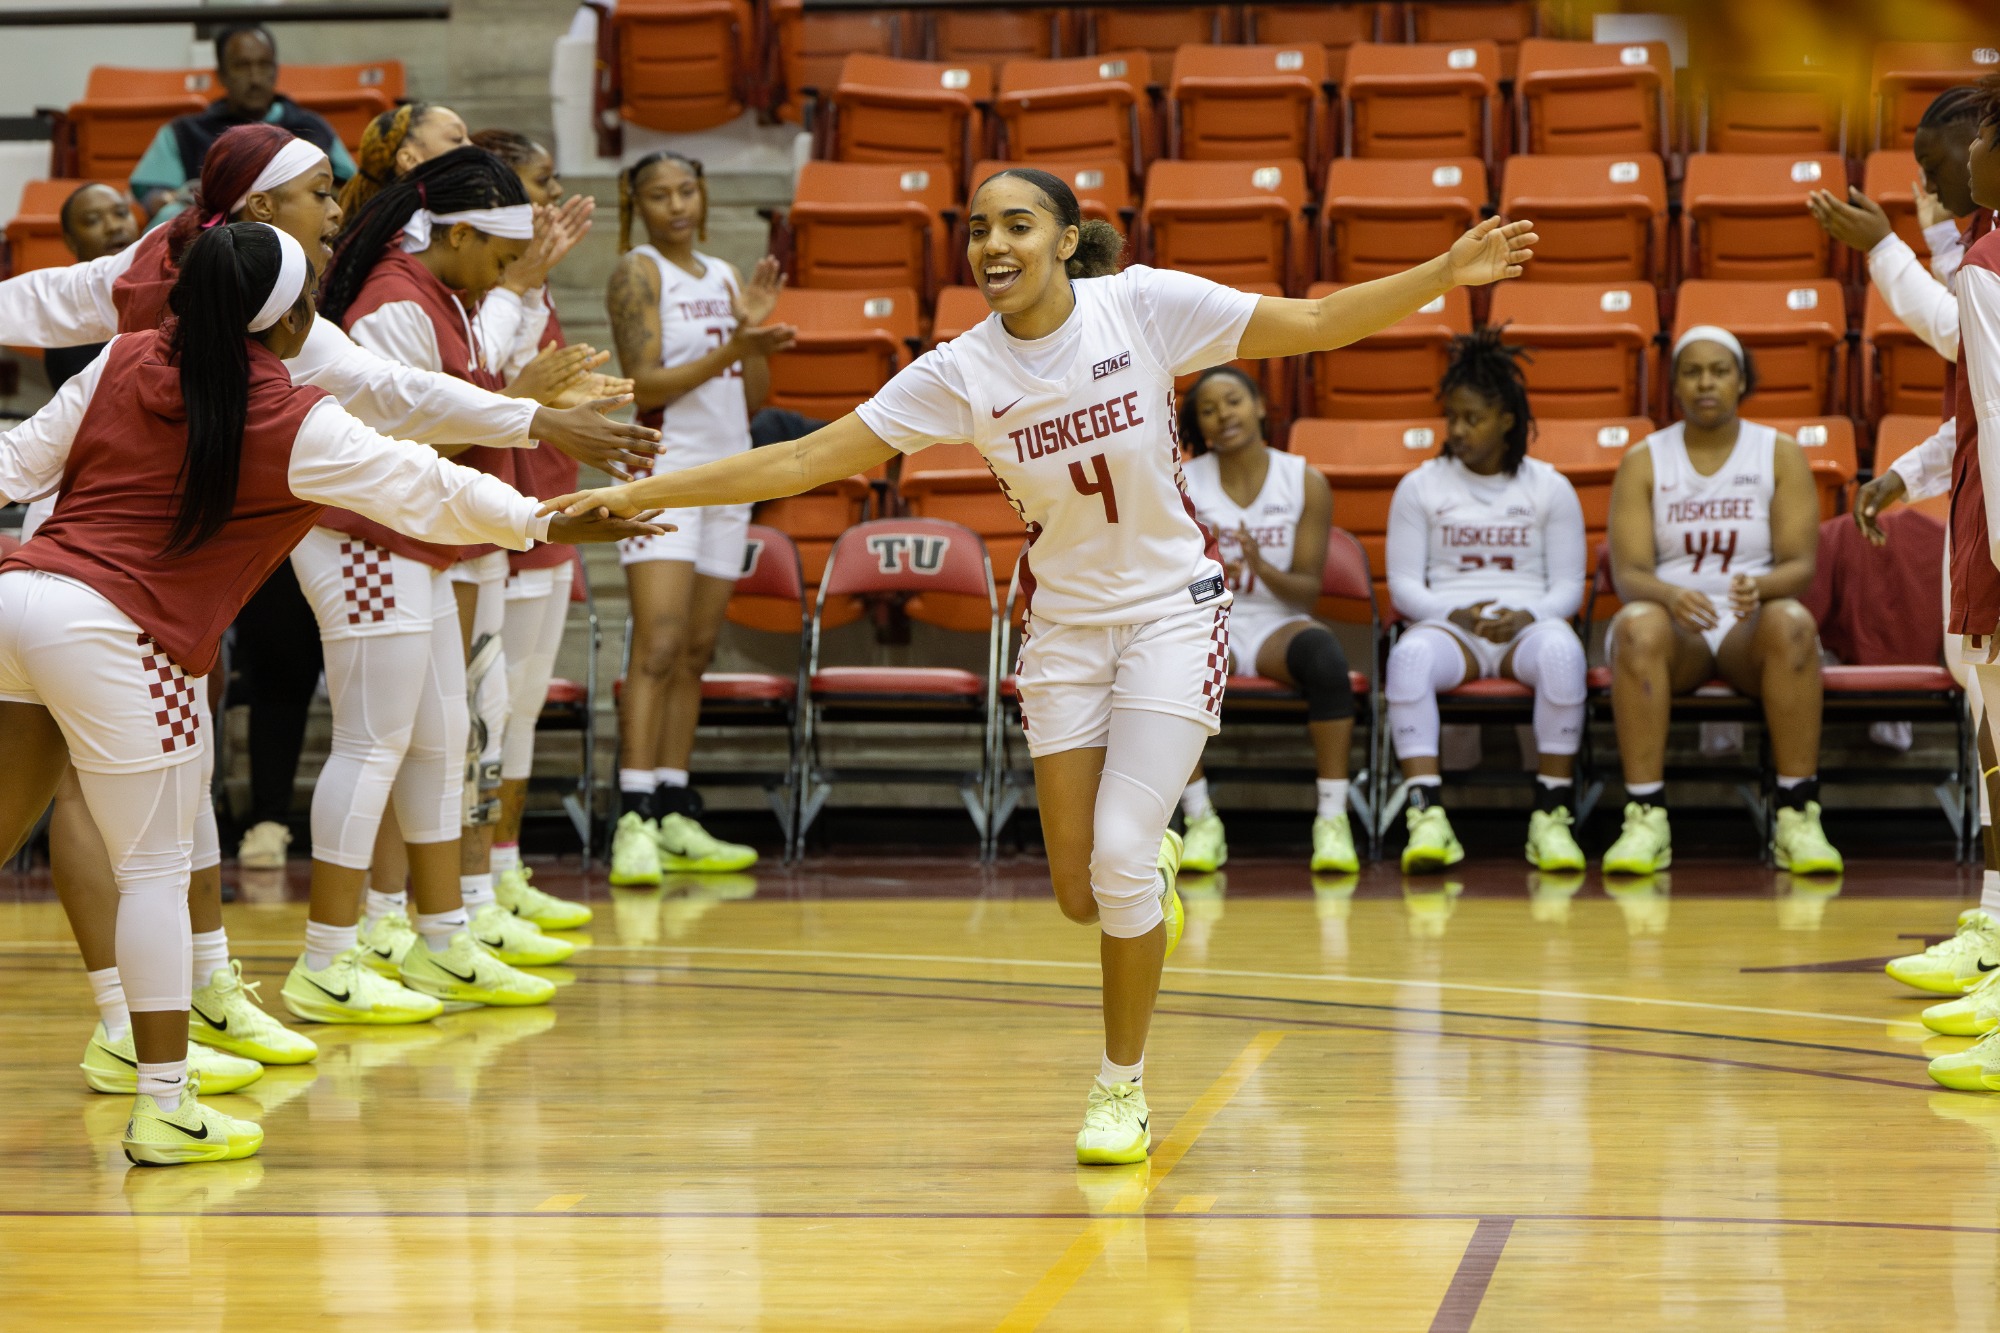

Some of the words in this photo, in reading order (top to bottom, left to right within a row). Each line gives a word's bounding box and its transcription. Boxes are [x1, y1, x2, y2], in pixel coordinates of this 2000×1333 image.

[1093, 351, 1130, 380] SIAC
[1008, 390, 1145, 463] TUSKEGEE
[1067, 452, 1119, 524] 4
[1666, 498, 1755, 523] TUSKEGEE
[866, 533, 951, 576] TU
[1441, 524, 1531, 547] TUSKEGEE
[1684, 530, 1737, 574] 44
